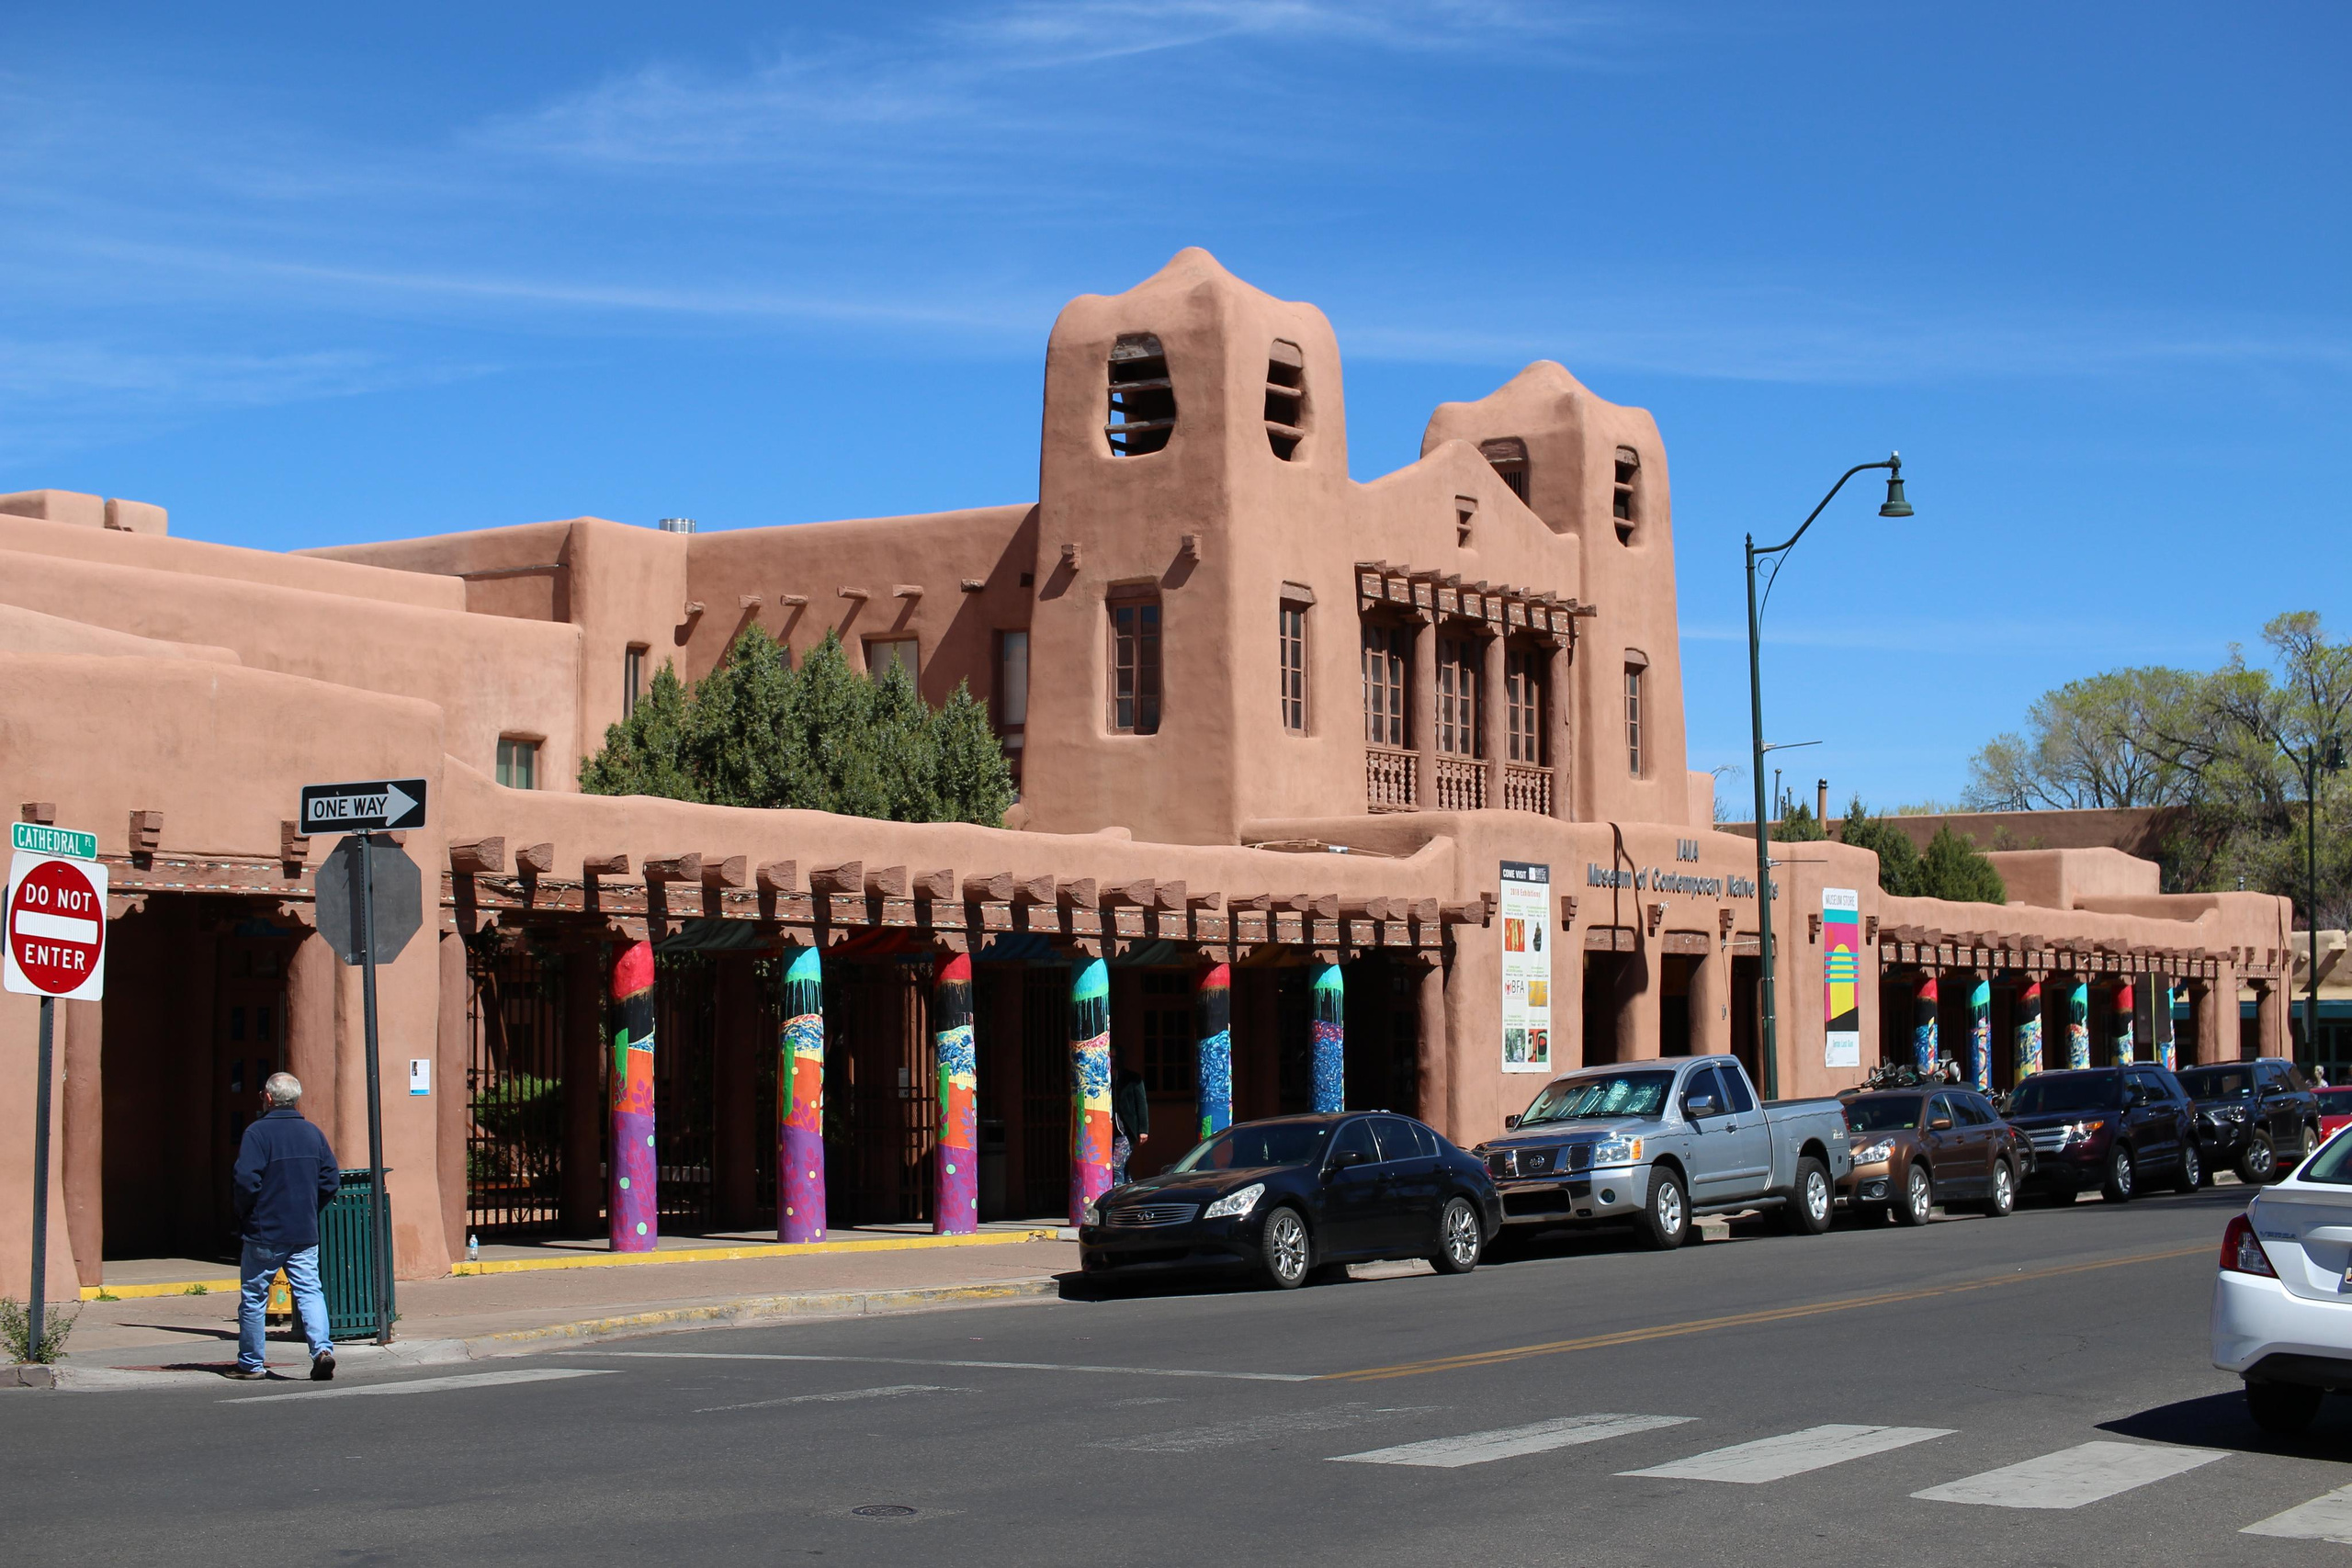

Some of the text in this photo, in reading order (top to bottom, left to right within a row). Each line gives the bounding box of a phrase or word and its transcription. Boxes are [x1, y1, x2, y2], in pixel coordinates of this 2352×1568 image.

[313, 796, 388, 818] ONE WAY
[17, 826, 92, 855] CATHEDRAL PL
[1676, 839, 1699, 863] IAIA
[1502, 868, 1516, 879] COME
[1515, 870, 1527, 880] VISIT
[1587, 863, 1633, 890] Museum
[1635, 866, 1648, 891] of
[1652, 866, 1724, 902] Contemporary
[1725, 874, 1756, 899] Native
[25, 883, 92, 912] DO NOT
[1825, 894, 1855, 908] MUSEUM STORE
[24, 942, 85, 971] ENTER
[1511, 980, 1525, 993] BFA
[2259, 1231, 2297, 1239] VERSA
